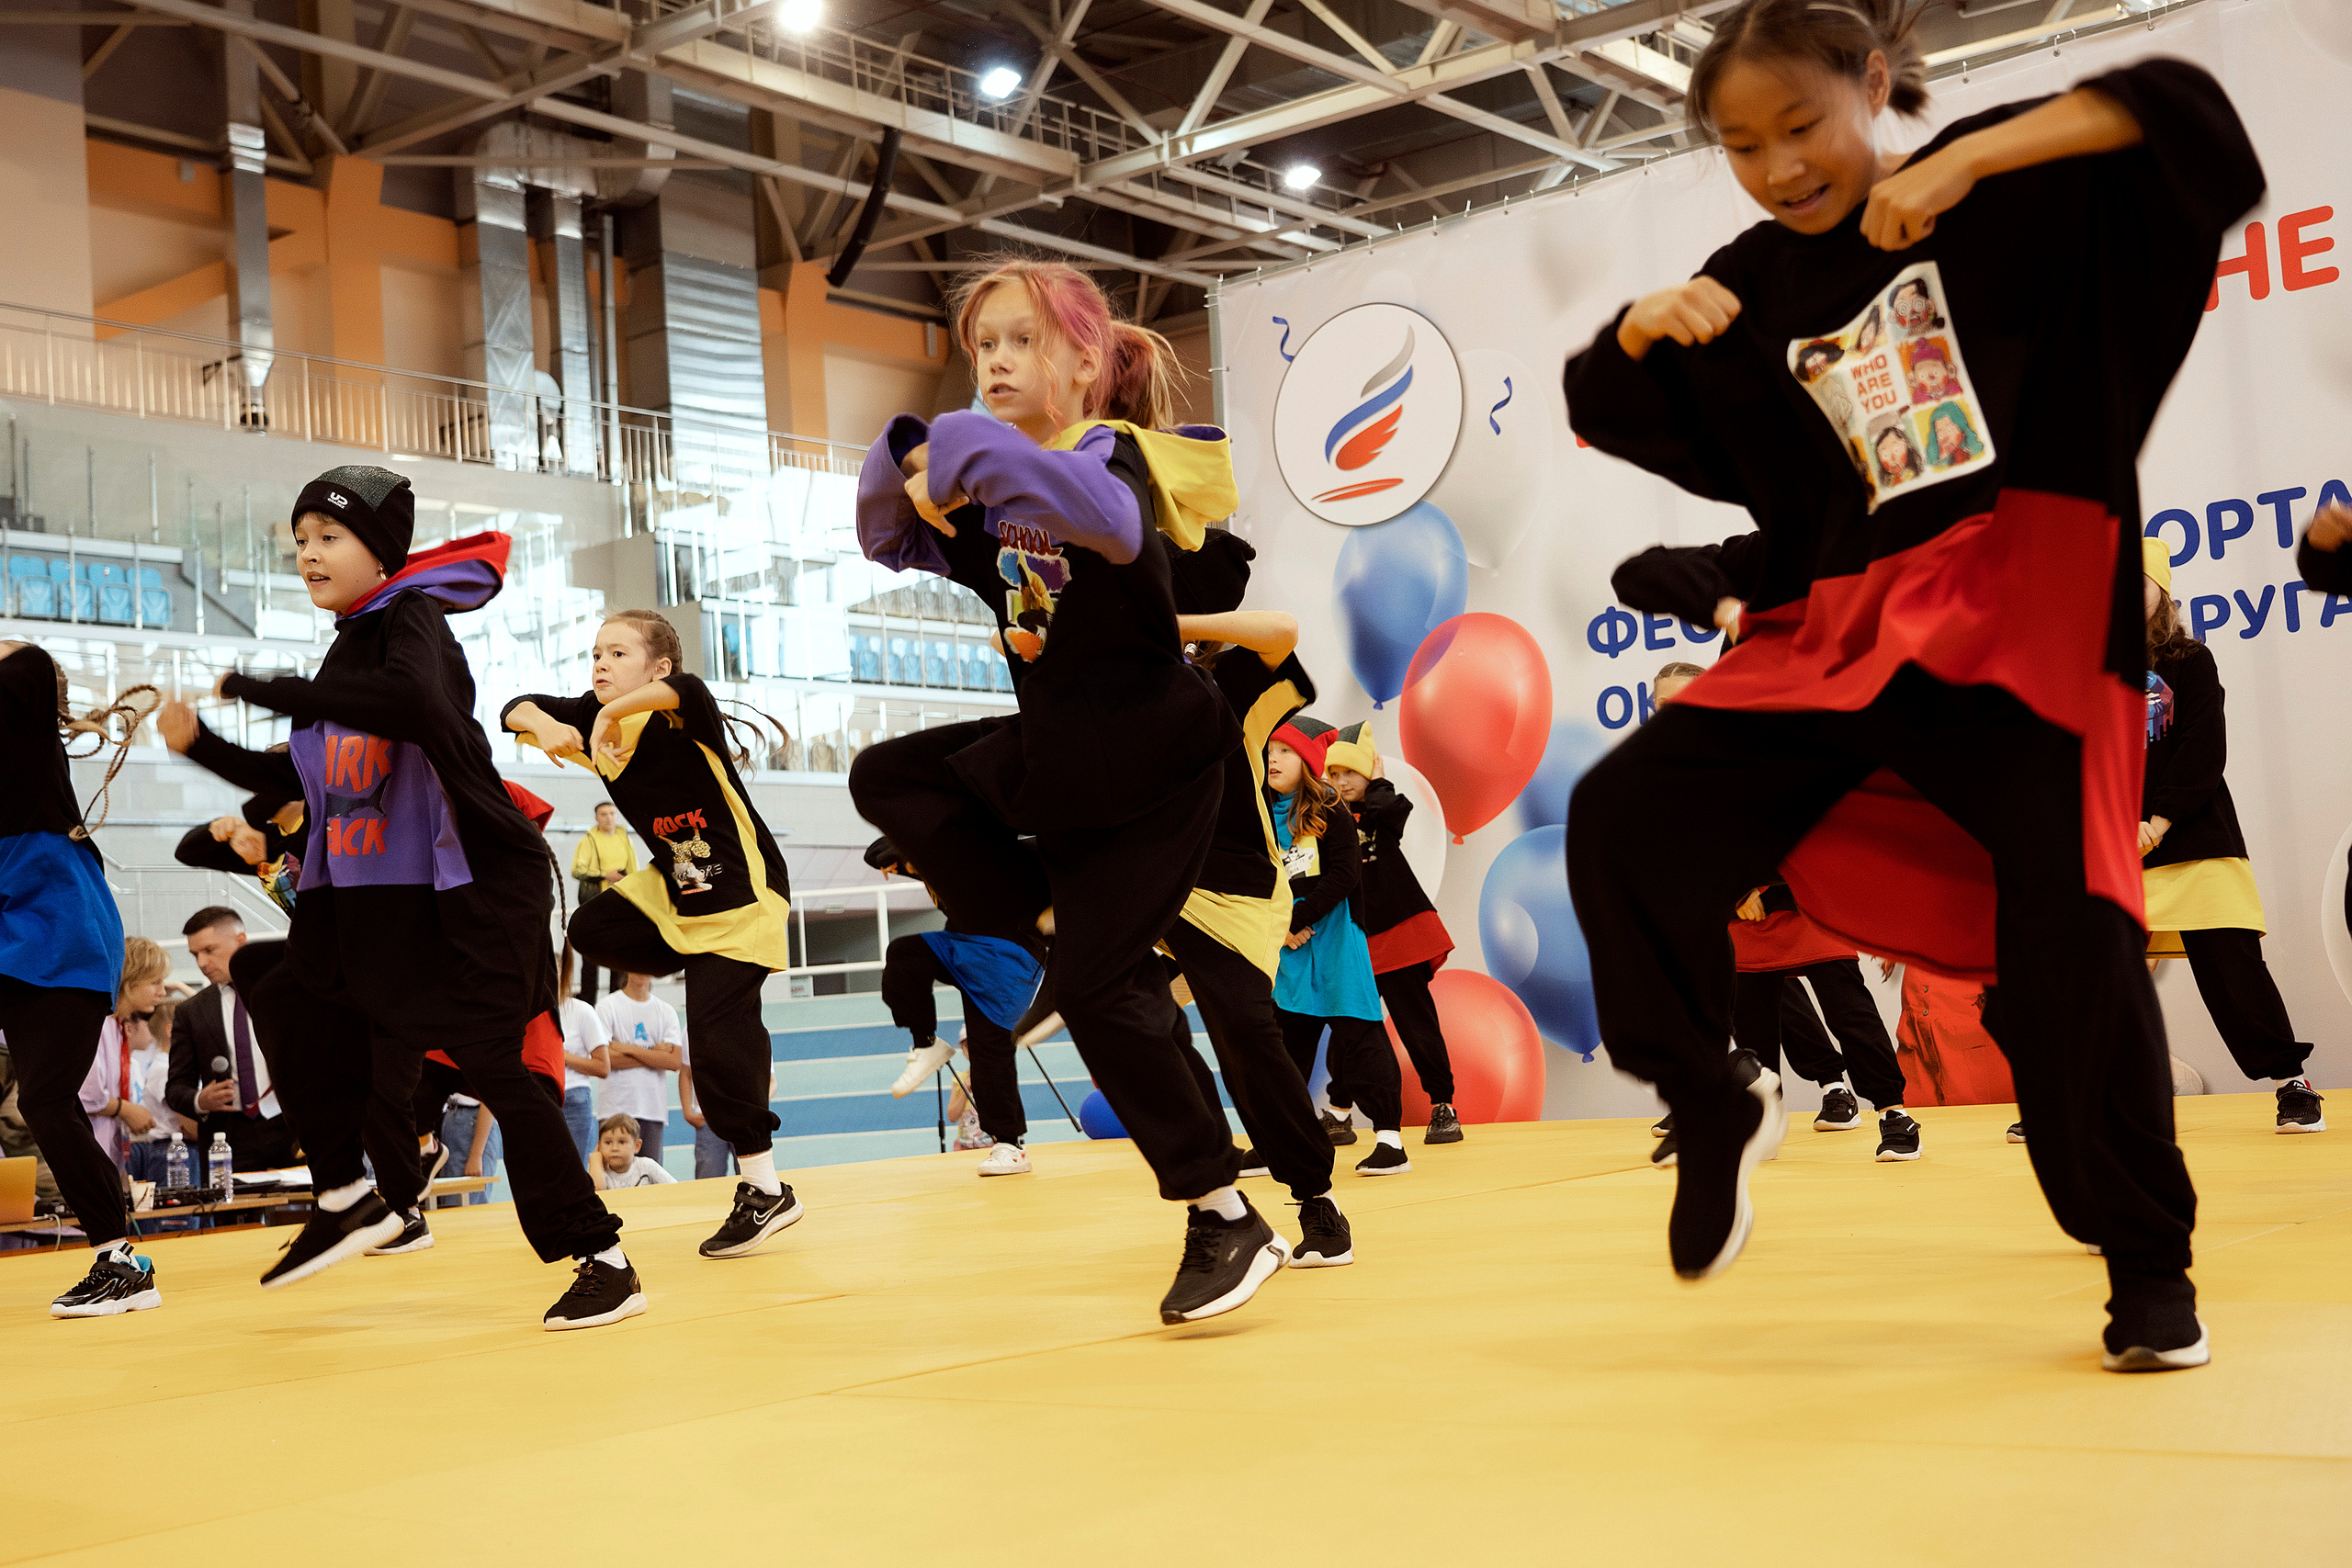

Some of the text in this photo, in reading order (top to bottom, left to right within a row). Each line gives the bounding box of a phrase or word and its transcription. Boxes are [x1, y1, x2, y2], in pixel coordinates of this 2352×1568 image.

[1850, 354, 1887, 379] WHO
[1857, 372, 1893, 397] ARE
[1860, 389, 1896, 414] YOU
[653, 808, 707, 838] ROCK
